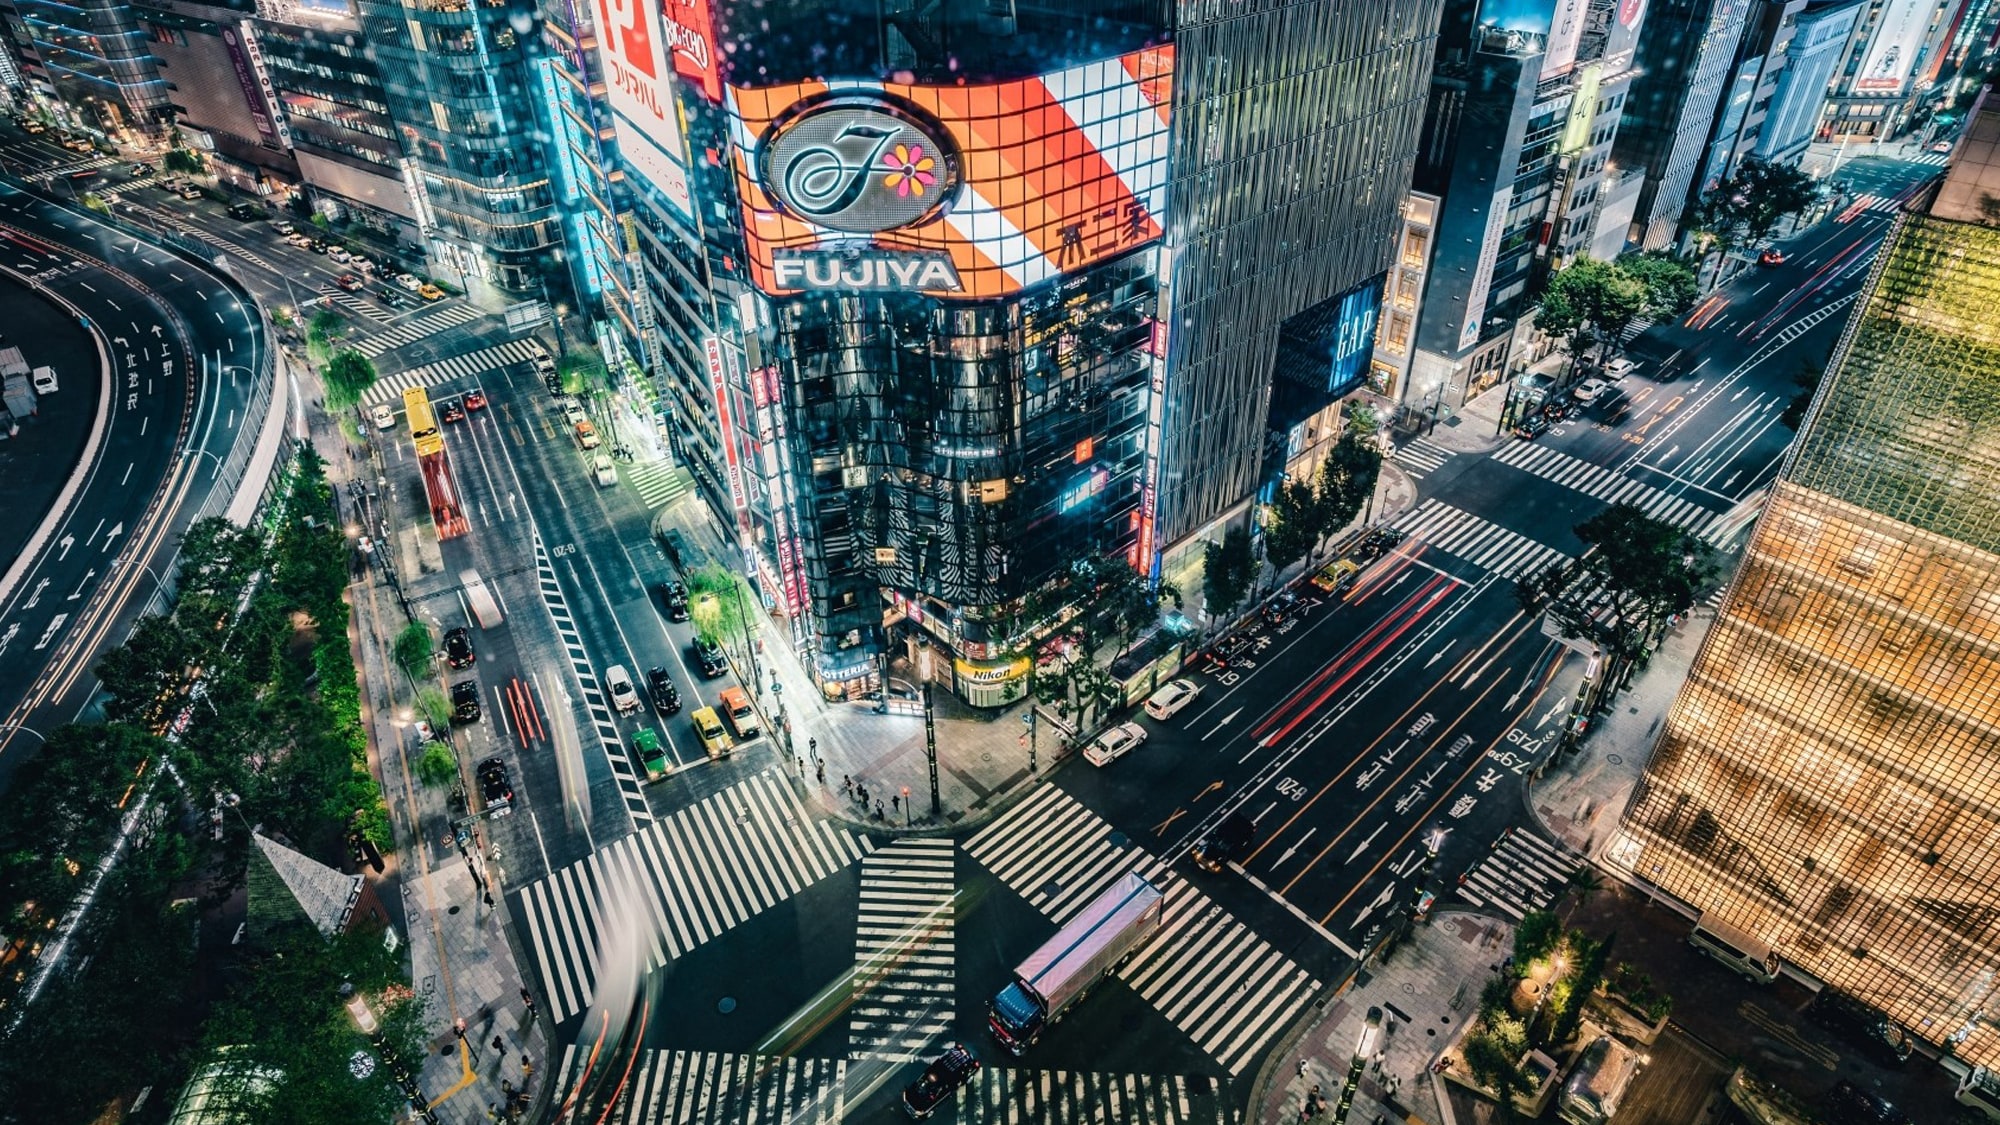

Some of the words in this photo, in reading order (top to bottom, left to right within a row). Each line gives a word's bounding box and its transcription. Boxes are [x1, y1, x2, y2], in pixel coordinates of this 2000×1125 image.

[679, 26, 708, 70] ECHO
[610, 59, 664, 121] プリマハム
[1055, 195, 1151, 271] 不二家
[774, 256, 955, 289] FUJIYA
[1336, 309, 1373, 362] GAP
[818, 660, 869, 682] LOTTERIA
[973, 668, 1011, 681] Nikon
[1355, 711, 1439, 793] 地下道
[1395, 733, 1477, 817] 地下道
[1275, 775, 1310, 803] 8-20
